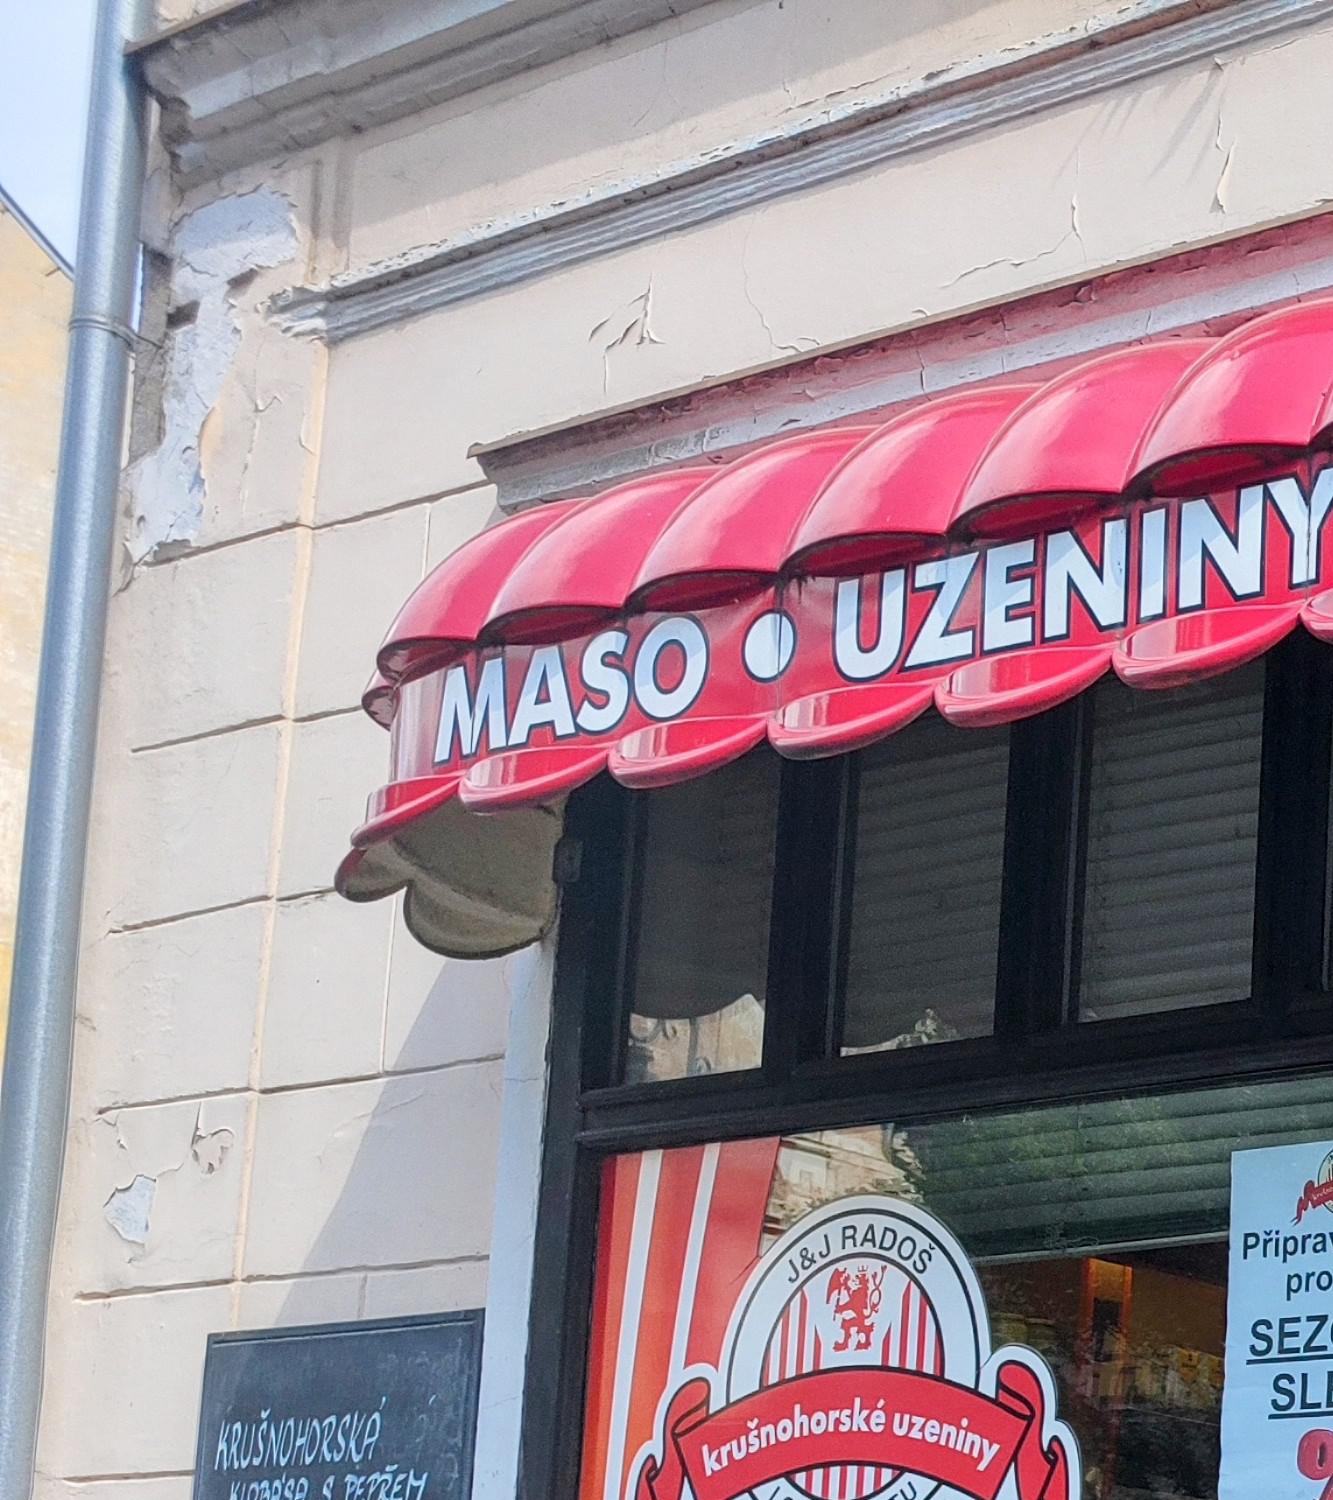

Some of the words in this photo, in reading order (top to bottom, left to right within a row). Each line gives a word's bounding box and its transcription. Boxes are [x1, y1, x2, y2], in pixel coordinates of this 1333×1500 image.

[432, 612, 711, 764] MASO
[787, 1233, 831, 1283] J&J
[841, 1223, 936, 1274] RADOŠ
[1286, 1270, 1333, 1301] pro
[214, 1396, 387, 1471] KRUŠNOHORSKÁ
[702, 1397, 885, 1477] krušnohorské
[892, 1412, 1000, 1472] uzeniny
